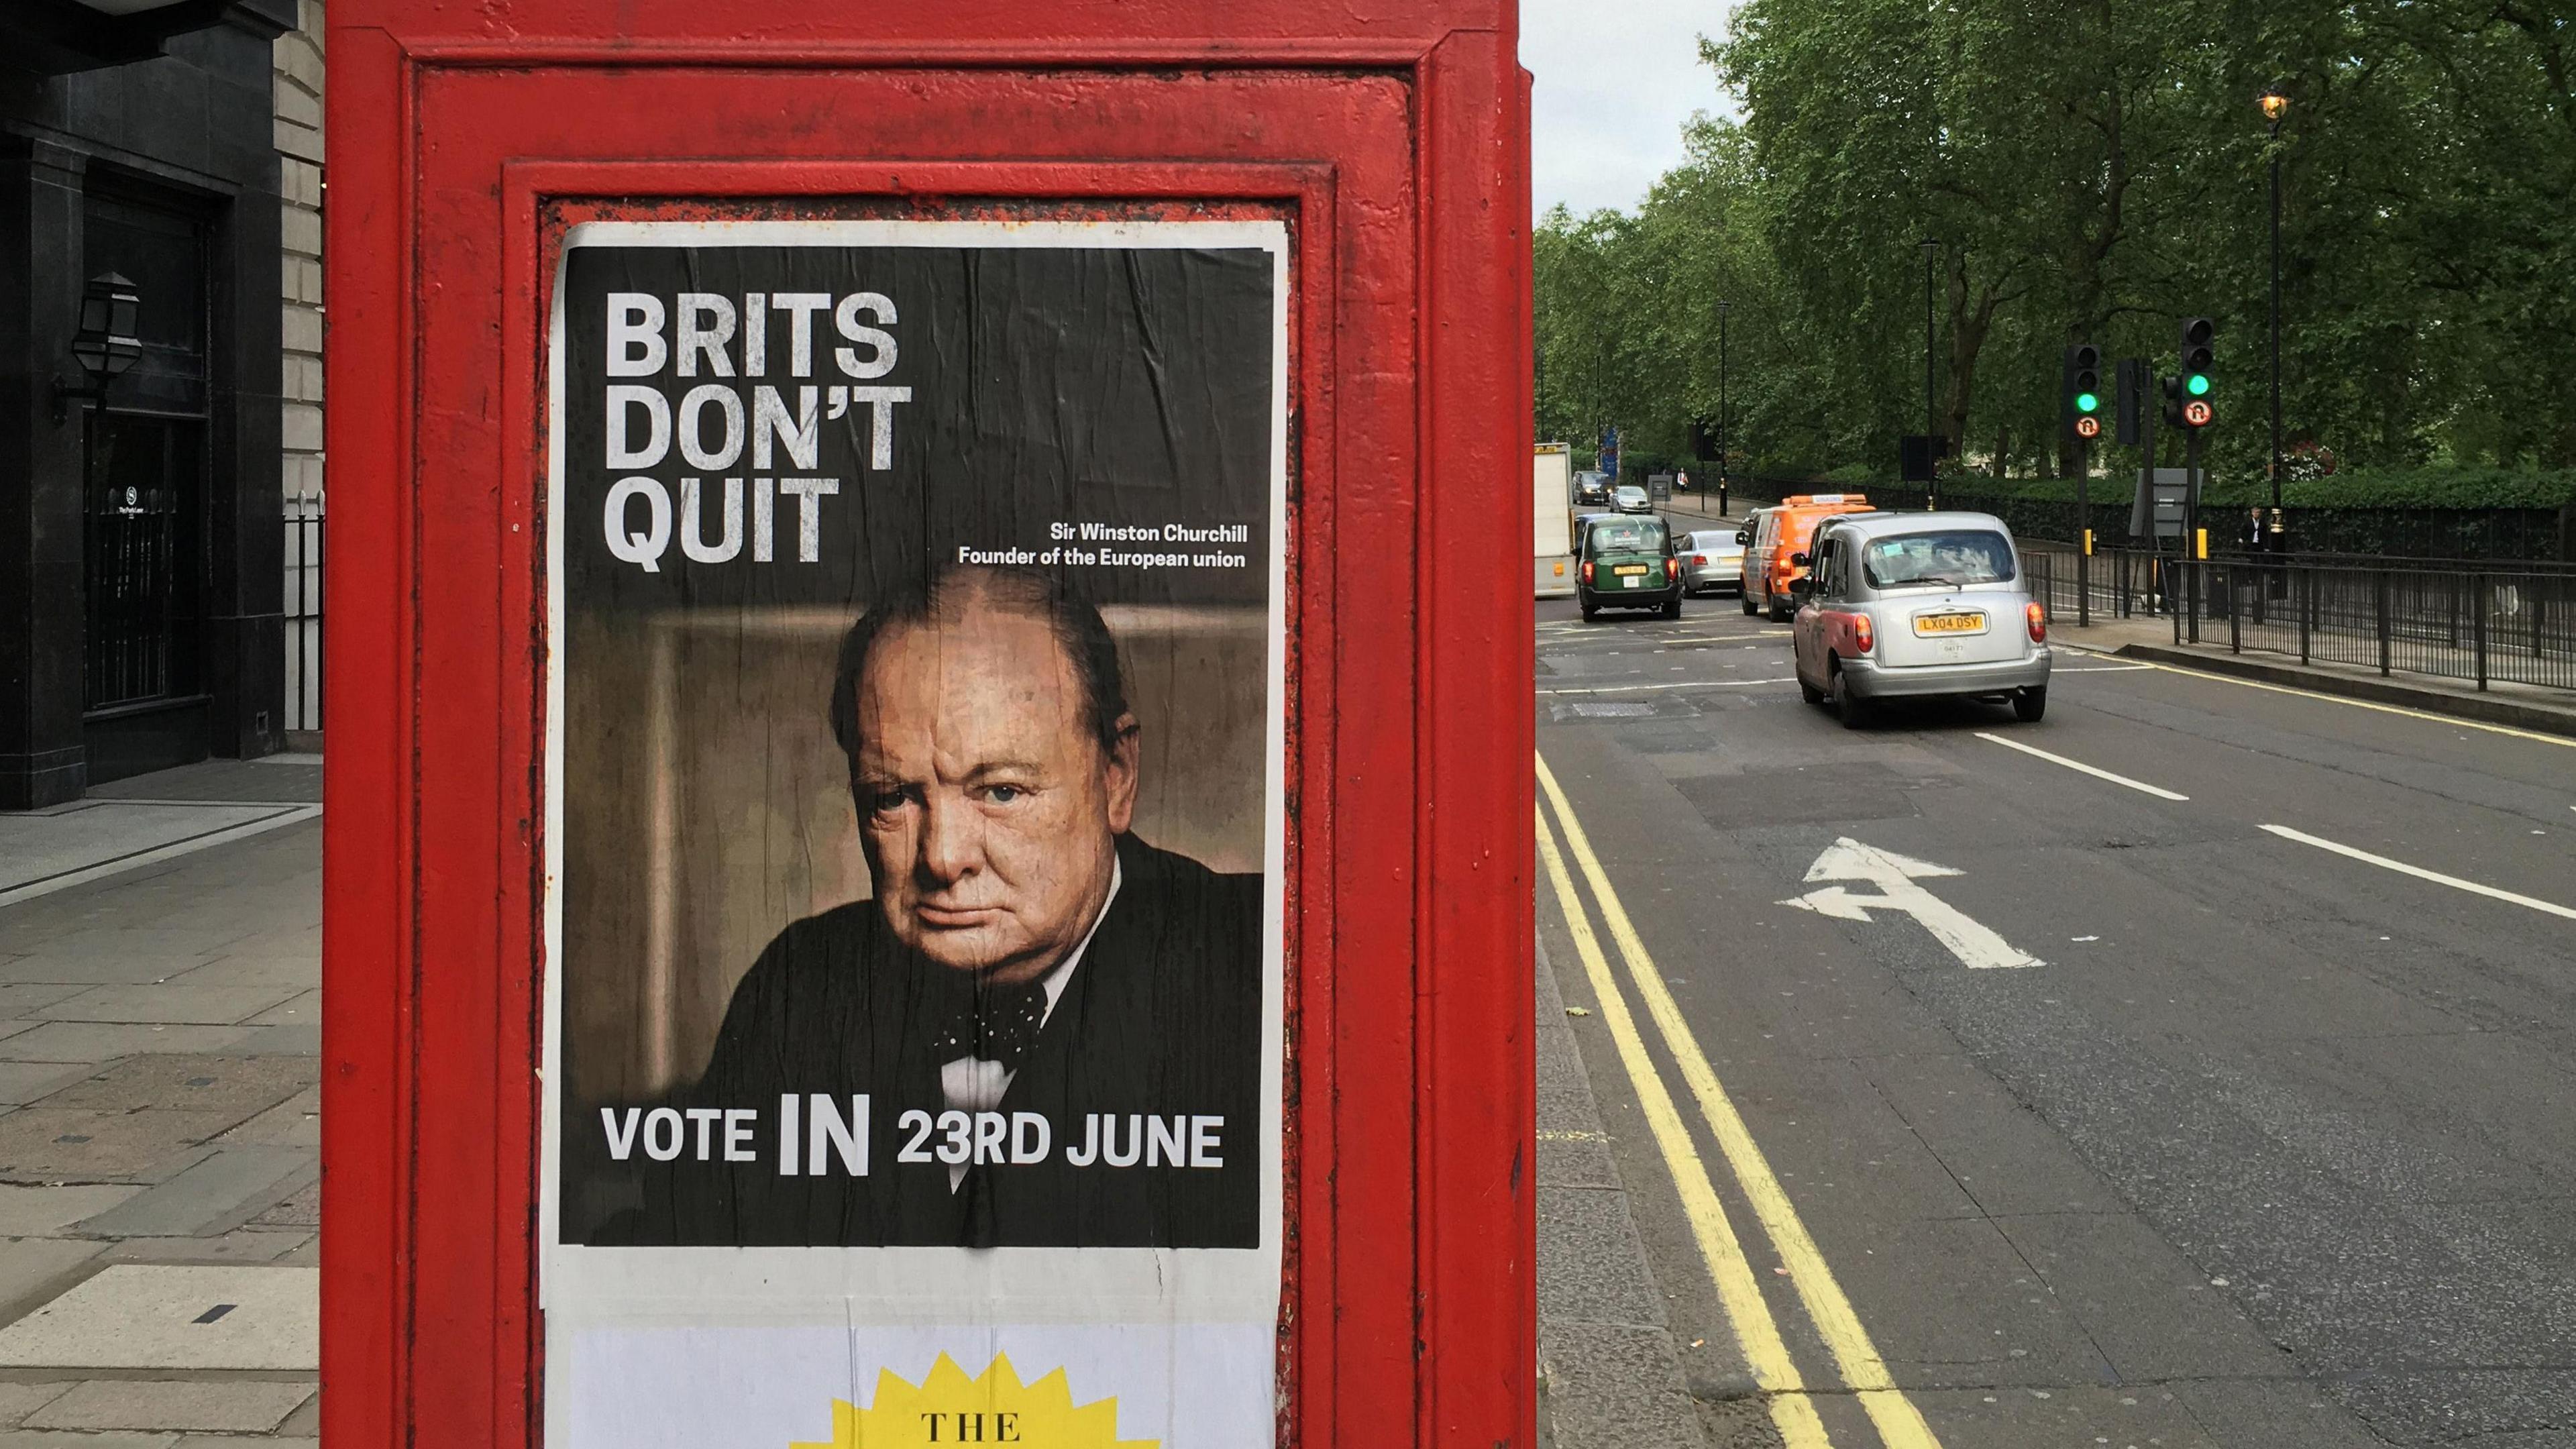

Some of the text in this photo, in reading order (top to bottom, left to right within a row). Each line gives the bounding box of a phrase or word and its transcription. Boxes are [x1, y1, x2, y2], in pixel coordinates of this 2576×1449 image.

[606, 292, 898, 379] BRITS
[606, 384, 912, 471] DON'T
[604, 476, 840, 573] QUIT
[1050, 522, 1248, 543] Sir Winston Churchill
[959, 546, 1246, 570] Founder of the European union
[1923, 616, 1978, 630] LX04 DSY
[600, 1093, 1226, 1177] VOTE IN 23RD JUNE
[921, 1413, 1021, 1442] THE
